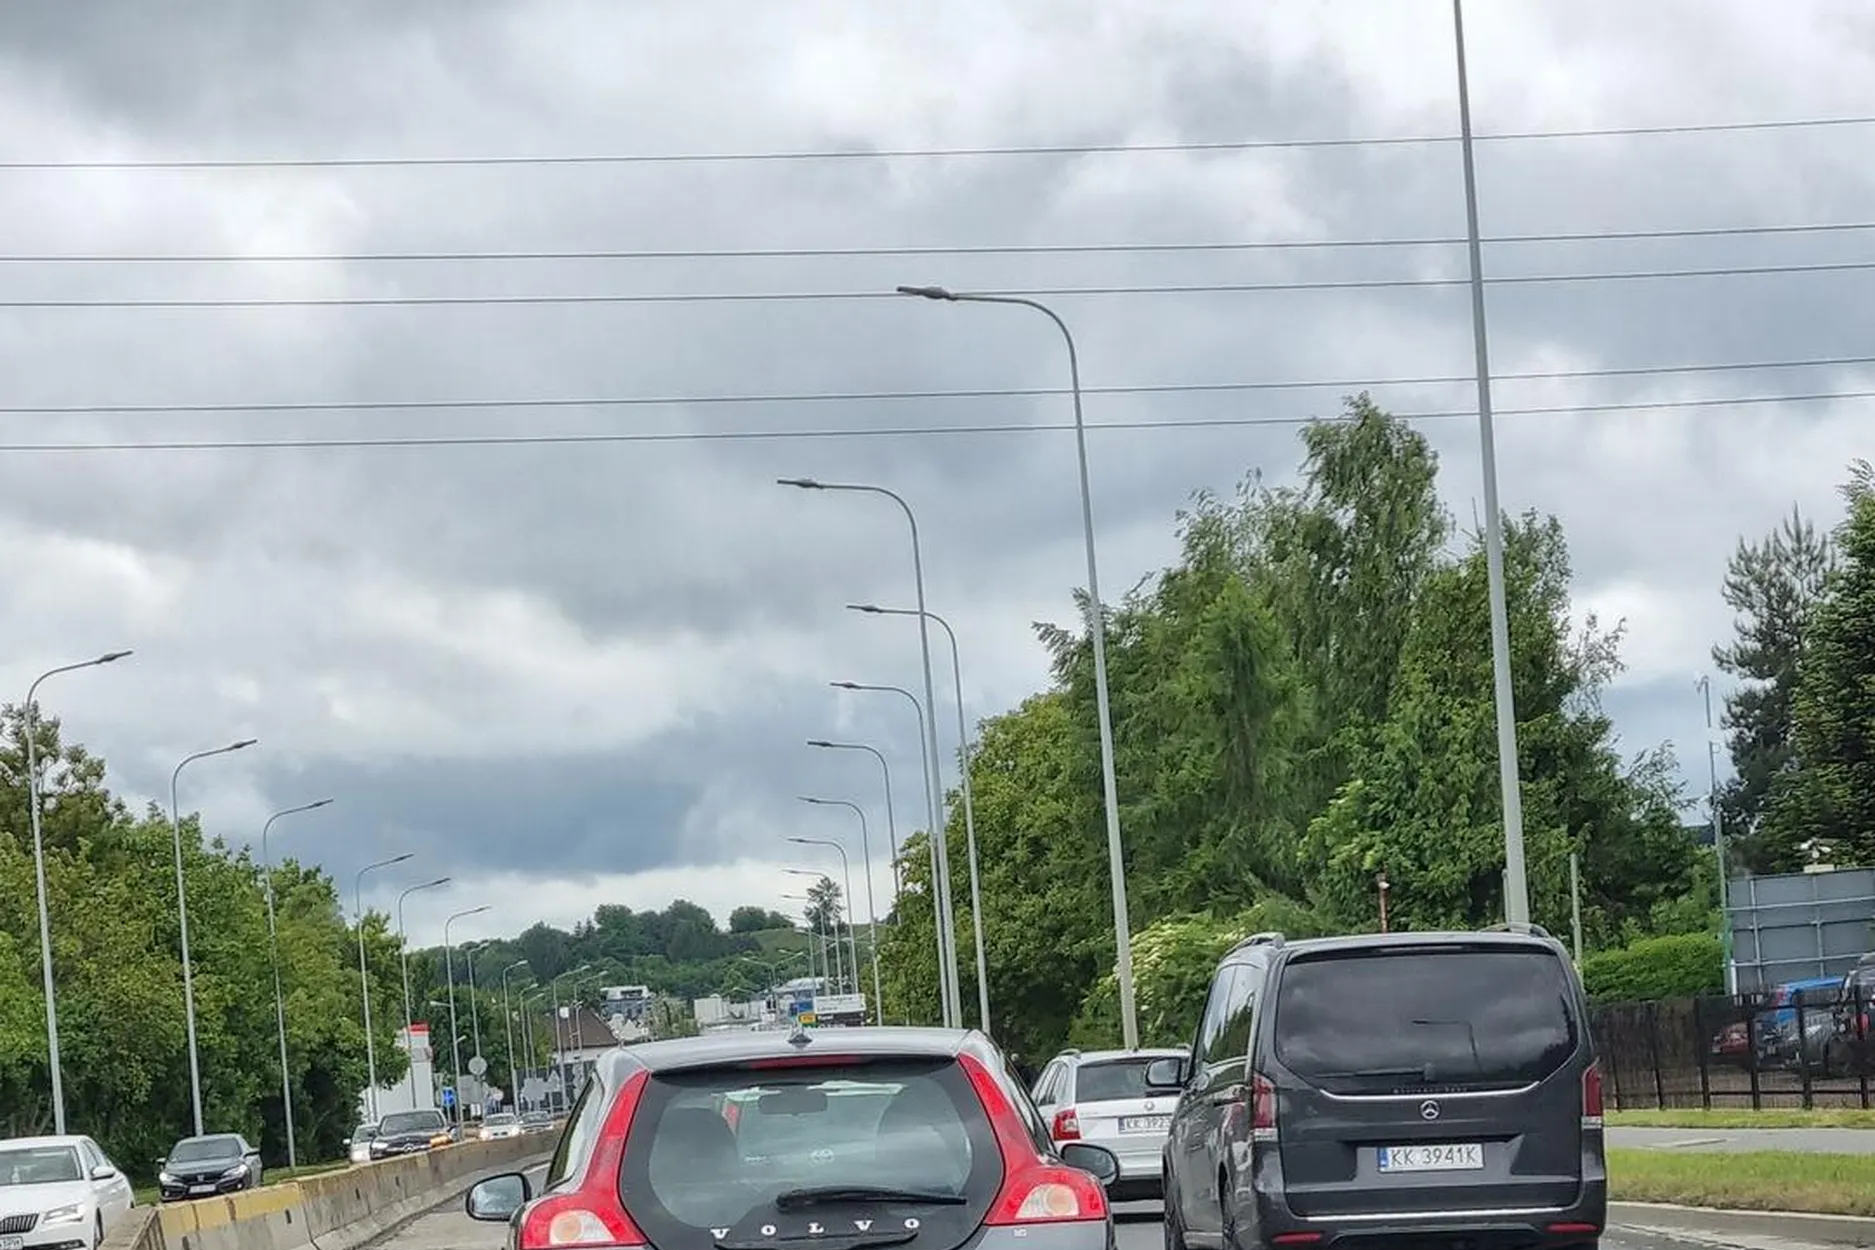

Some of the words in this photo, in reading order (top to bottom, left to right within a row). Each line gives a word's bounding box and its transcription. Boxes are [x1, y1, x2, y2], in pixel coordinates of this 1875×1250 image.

[1391, 1148, 1414, 1165] KK
[1422, 1146, 1476, 1164] 3941K
[710, 1218, 920, 1239] VOLVO
